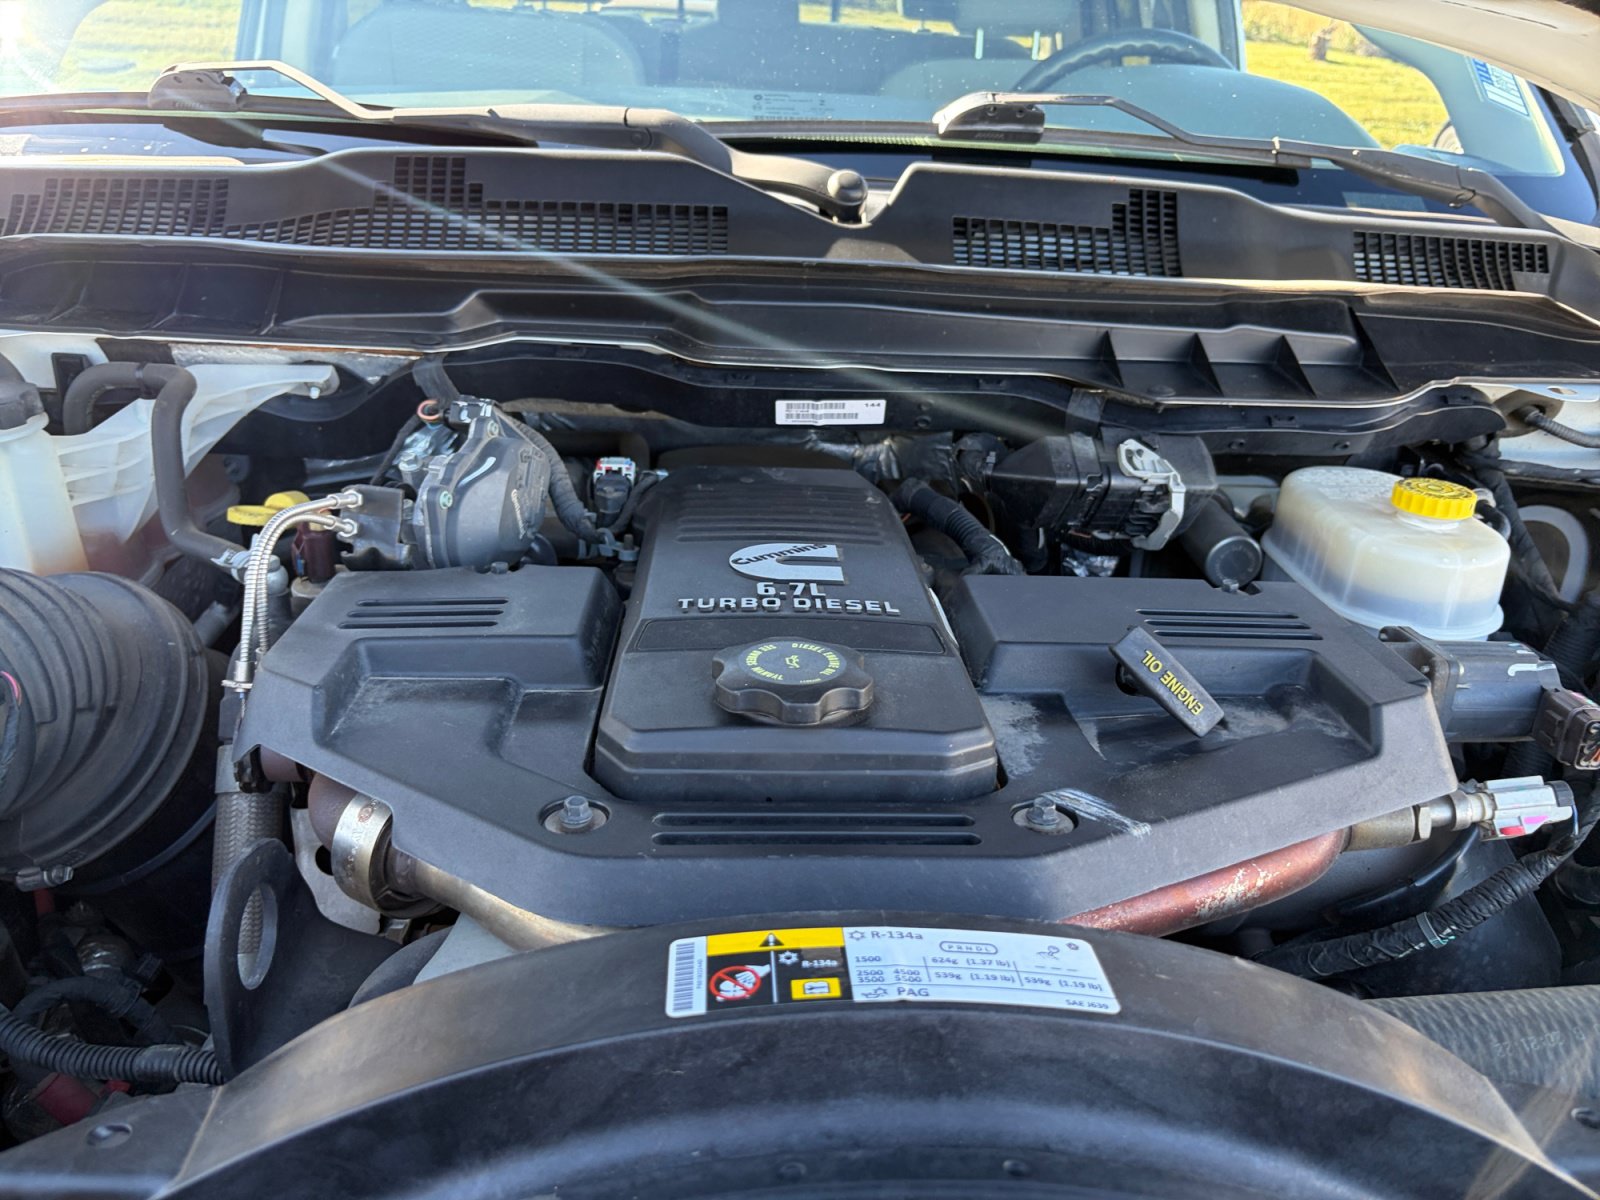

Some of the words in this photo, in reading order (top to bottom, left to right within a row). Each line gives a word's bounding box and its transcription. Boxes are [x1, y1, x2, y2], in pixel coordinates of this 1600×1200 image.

[731, 543, 828, 566] Cummins
[756, 582, 826, 598] 6.7L
[678, 597, 781, 612] TURBO
[793, 597, 901, 616] DIESEL
[792, 642, 825, 653] DIESEL
[823, 651, 840, 669] ENGINE
[1142, 650, 1163, 673] OIL
[752, 667, 784, 681] MANUAL
[1160, 670, 1205, 716] ENGINE
[870, 930, 924, 940] R-134a
[801, 959, 839, 968] R-134a
[854, 955, 882, 963] 1500
[931, 957, 959, 966] 624g
[966, 957, 993, 967] (1.37
[996, 959, 1011, 968] lb)
[893, 968, 921, 976] 4500
[934, 971, 962, 981] 539g
[970, 972, 998, 982] (1.19
[1000, 974, 1016, 984] lb)
[1024, 976, 1052, 986] 539g
[1058, 979, 1086, 989] (1.19
[1088, 981, 1103, 991] lb)
[895, 975, 923, 983] 5500
[897, 986, 931, 997] PAG
[1065, 999, 1085, 1007] SAE
